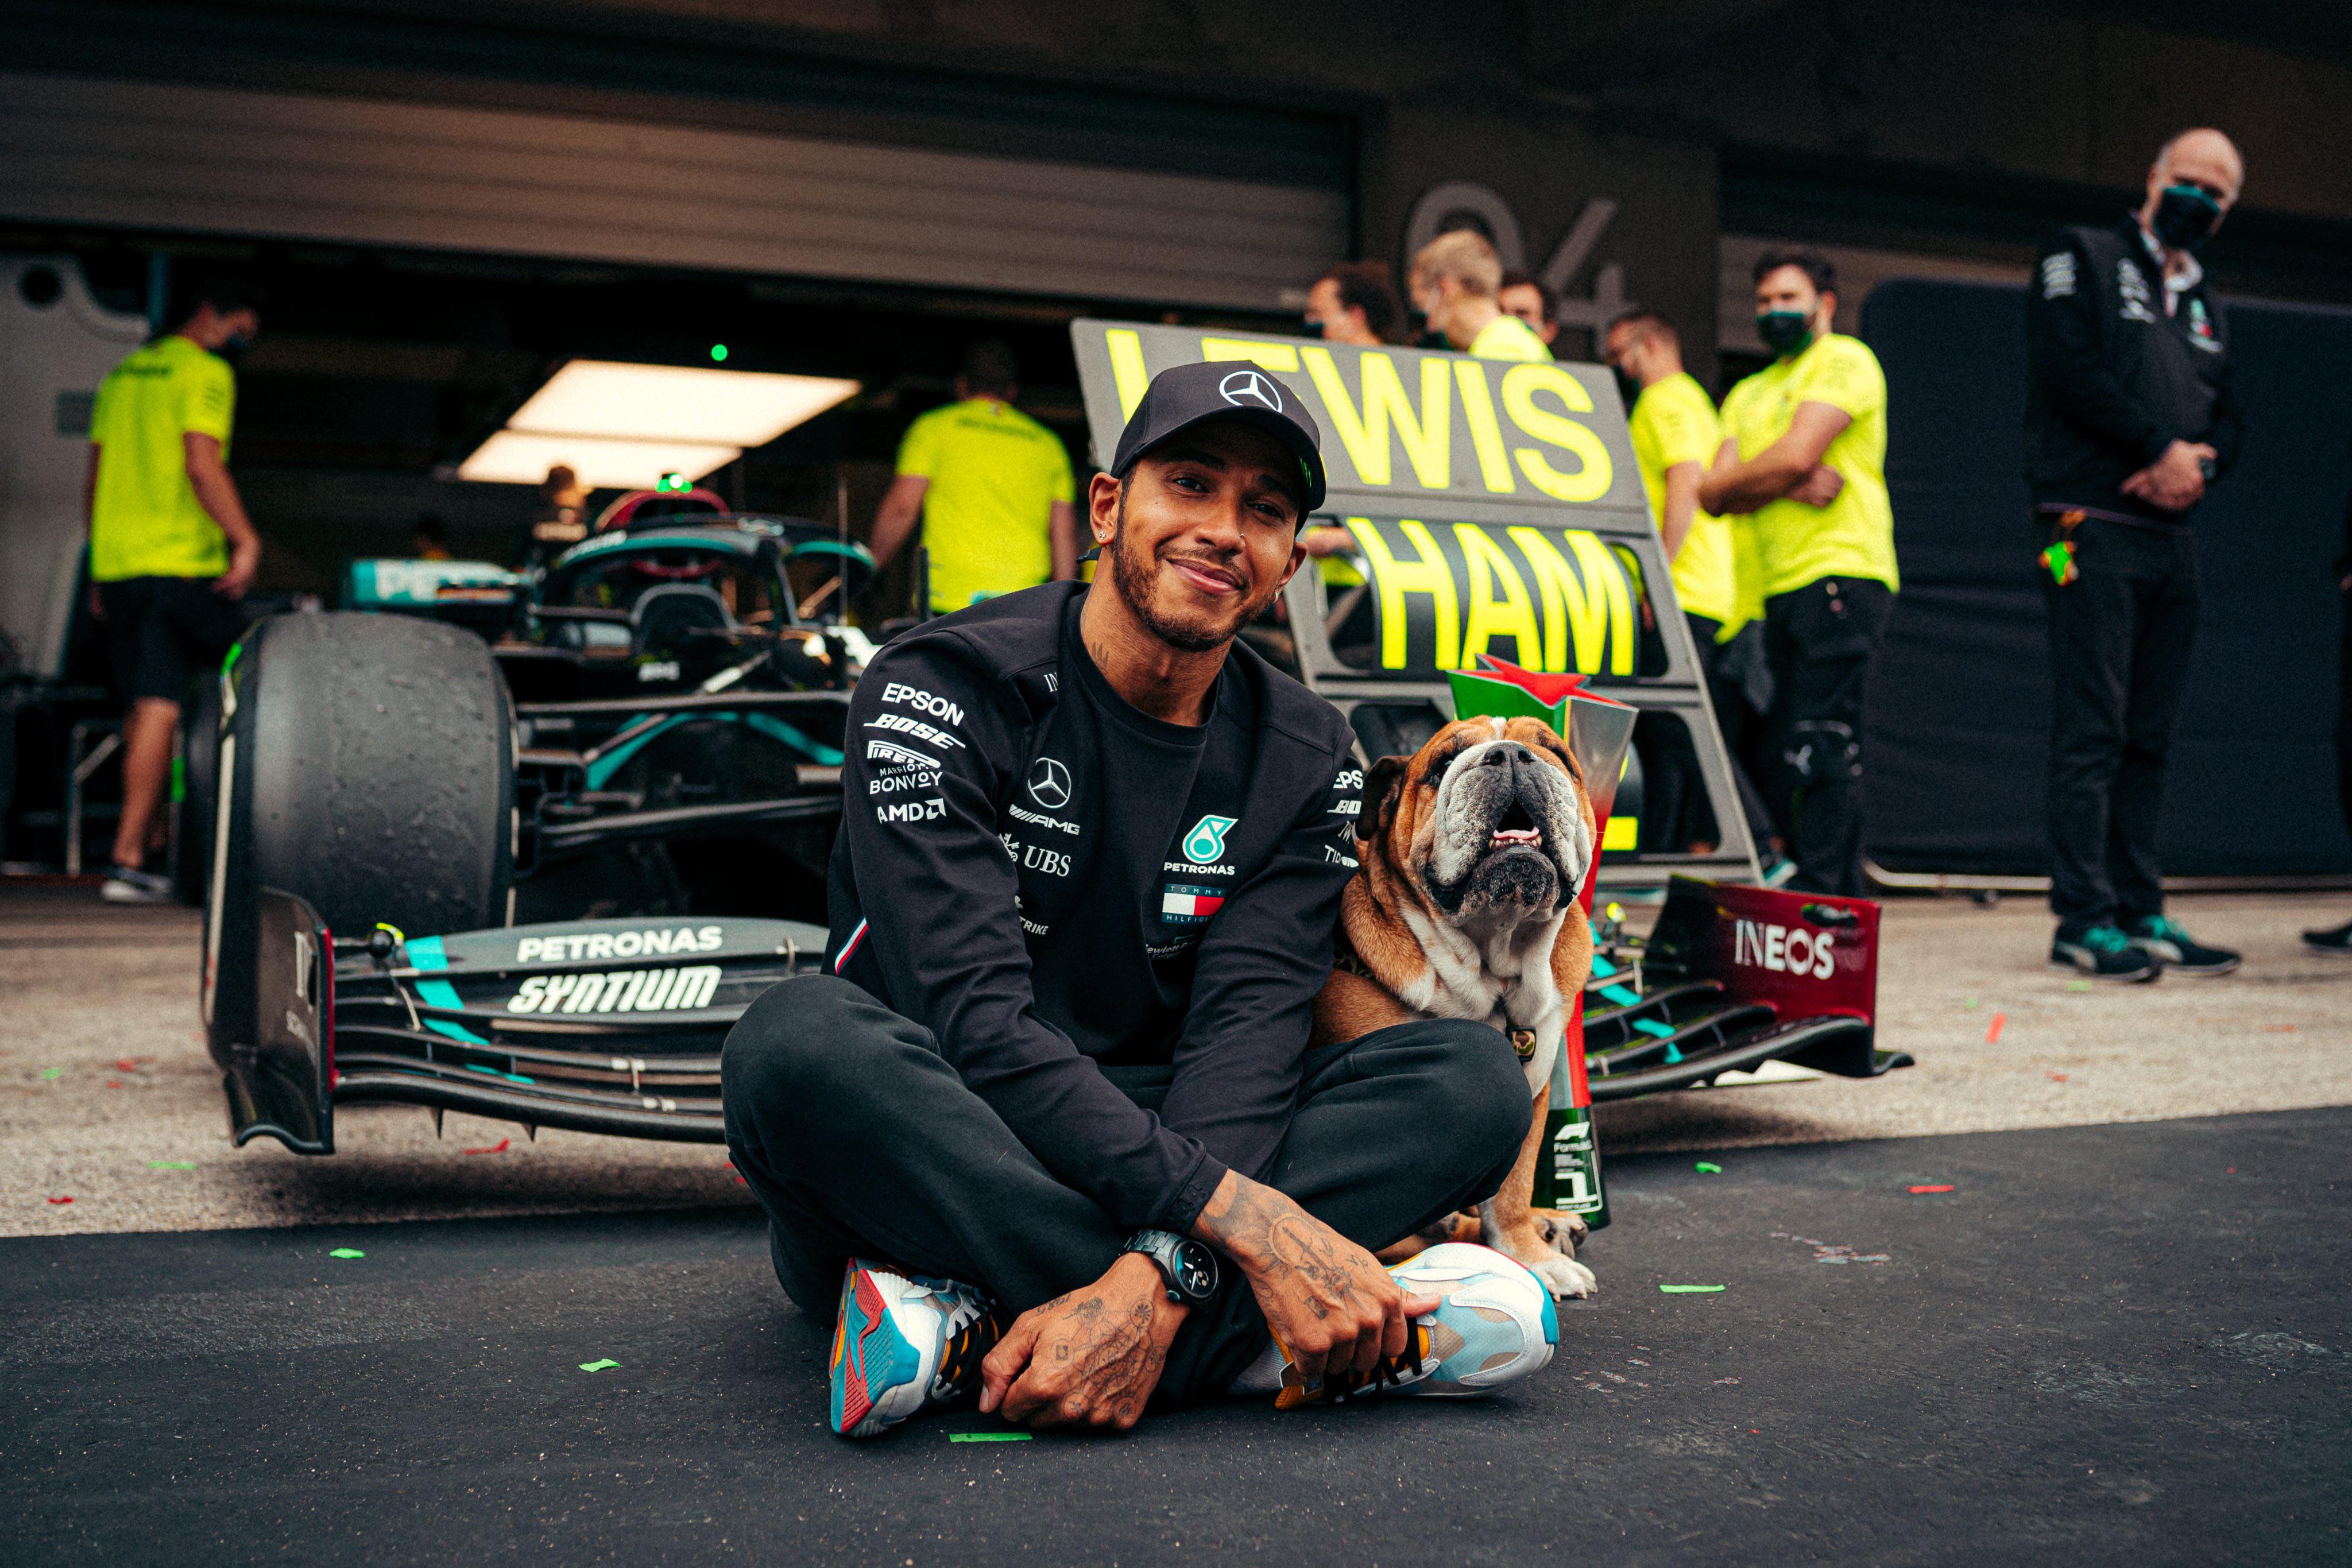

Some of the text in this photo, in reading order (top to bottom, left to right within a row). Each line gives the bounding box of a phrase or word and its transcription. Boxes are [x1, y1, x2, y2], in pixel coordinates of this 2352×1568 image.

[1105, 329, 1613, 502] WIS
[1347, 517, 1634, 676] HAM
[881, 683, 964, 726] EPSON
[863, 713, 966, 749] BOSE
[880, 764, 929, 776] MARRIOT
[1333, 769, 1363, 789] EPS
[869, 771, 943, 795] BONVOY
[877, 803, 925, 824] AMD
[1326, 799, 1362, 814] BO
[1032, 814, 1081, 835] AMG
[1024, 845, 1071, 877] UBS
[1163, 862, 1235, 876] PETRONAS
[1170, 886, 1222, 896] TOMMY
[1019, 915, 1049, 935] TRIKE
[1166, 915, 1209, 923] HILFIG
[517, 926, 723, 963] PETRONAS
[1146, 943, 1181, 954] ewlett
[1735, 919, 1835, 980] INEOS
[506, 965, 723, 1014] SYNTIUM
